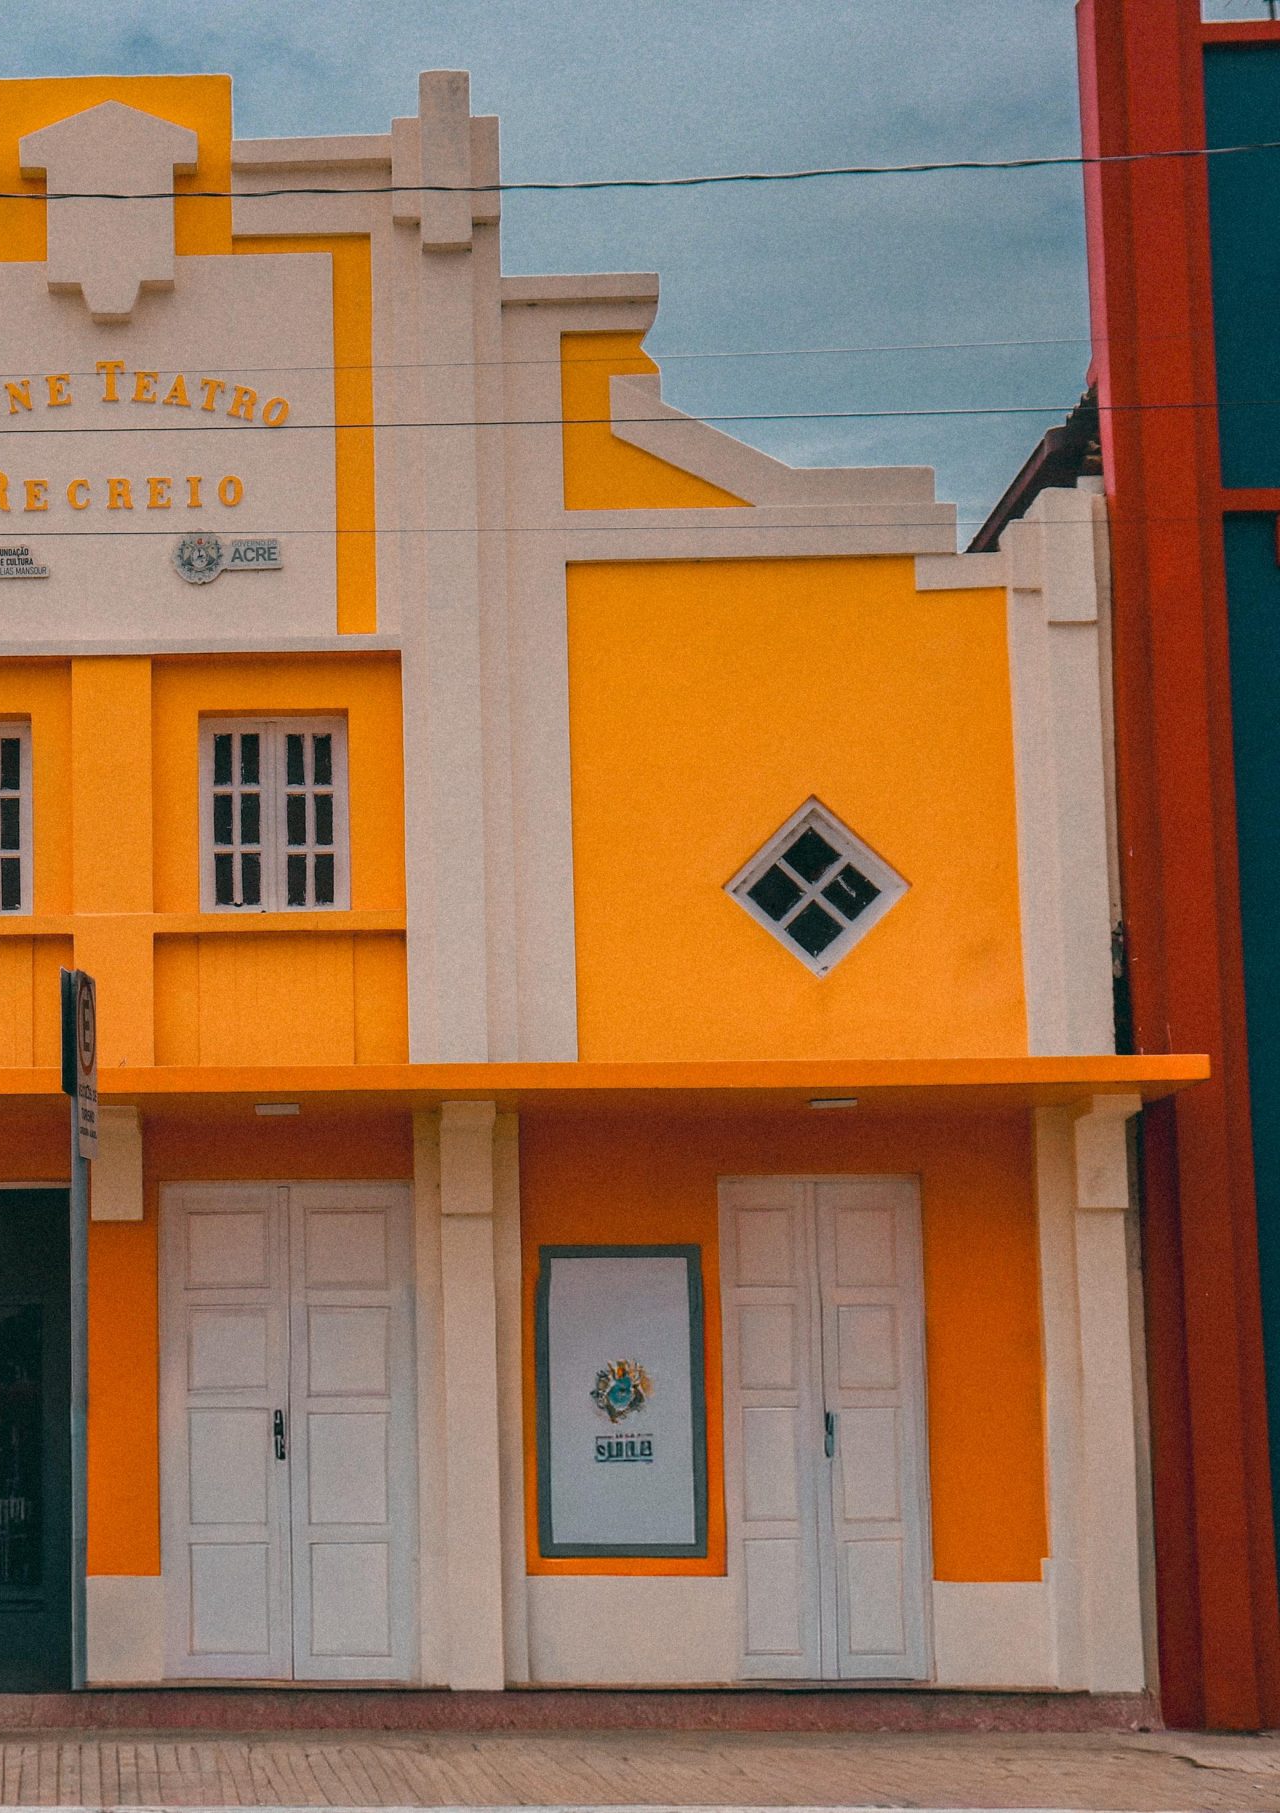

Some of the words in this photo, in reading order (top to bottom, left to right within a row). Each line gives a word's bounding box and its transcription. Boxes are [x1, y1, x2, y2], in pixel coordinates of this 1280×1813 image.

[96, 360, 289, 427] TEATRO
[231, 546, 278, 562] ACRE
[6, 557, 34, 566] CULTURA
[15, 566, 47, 575] MANSOUR
